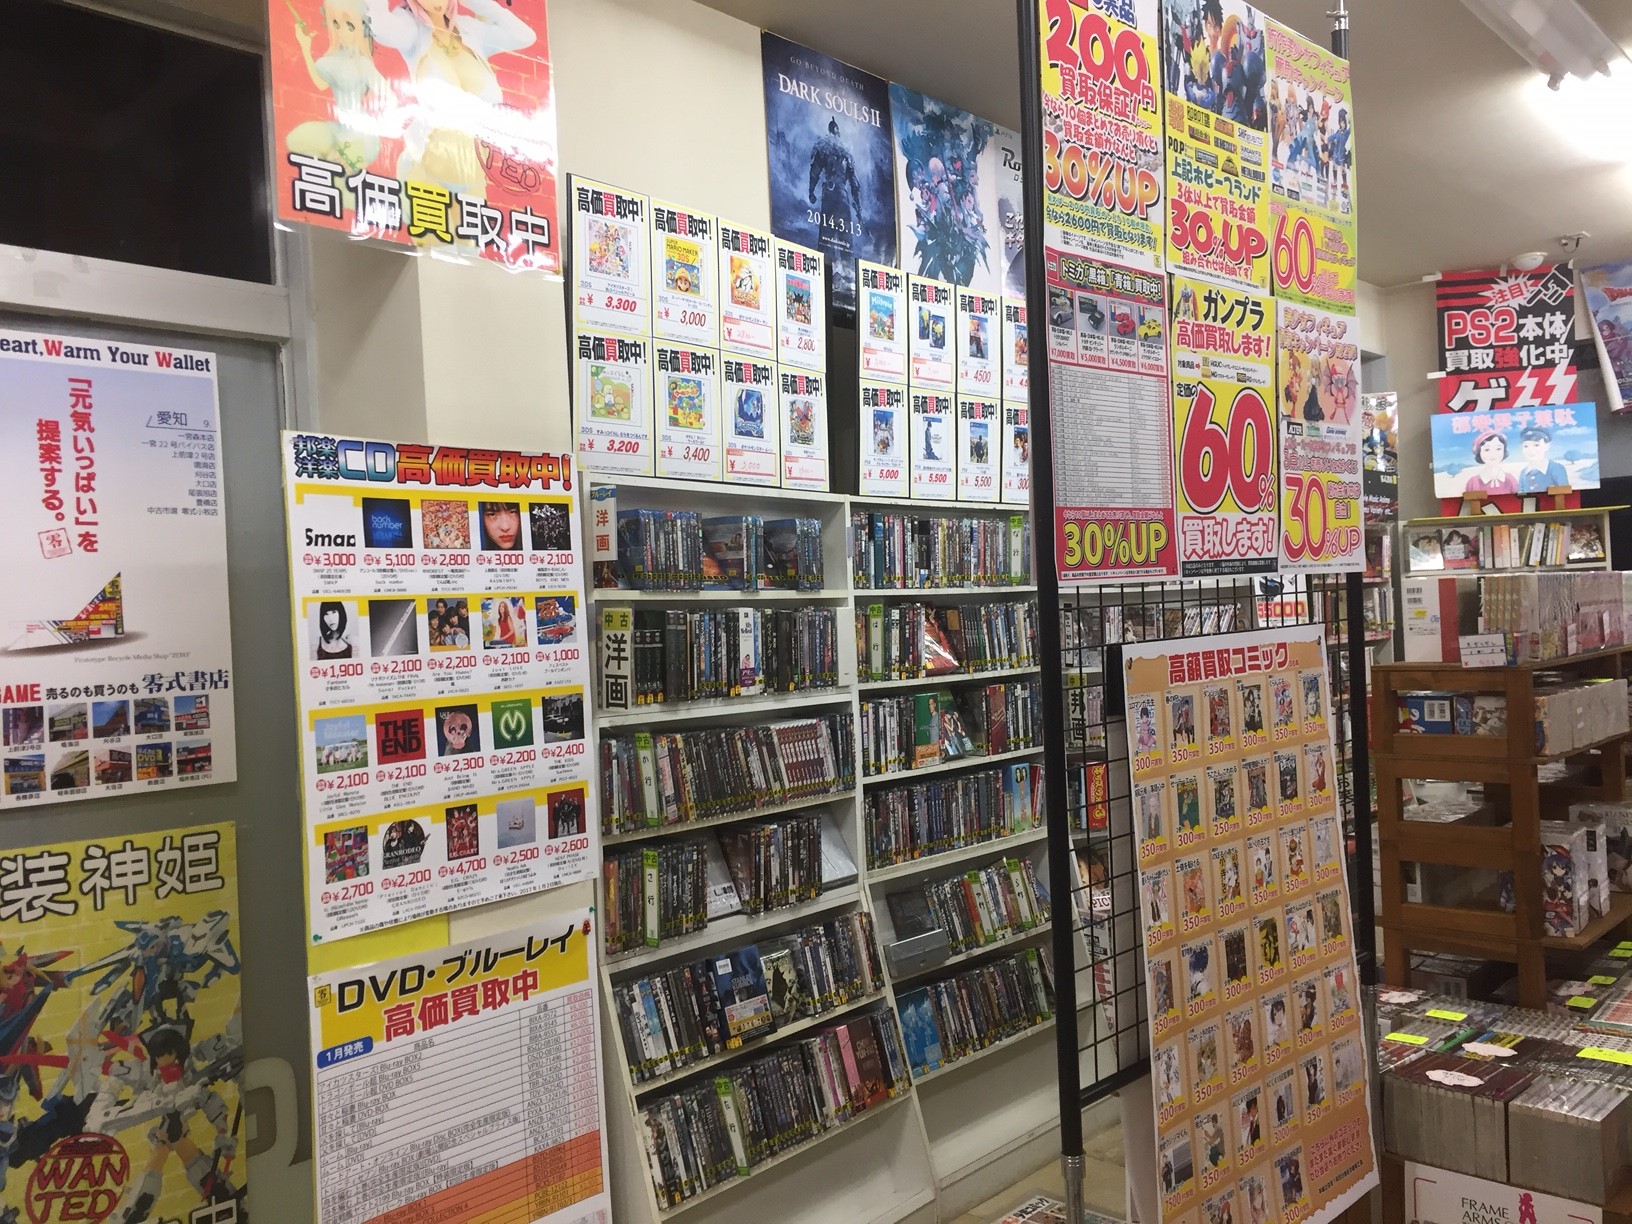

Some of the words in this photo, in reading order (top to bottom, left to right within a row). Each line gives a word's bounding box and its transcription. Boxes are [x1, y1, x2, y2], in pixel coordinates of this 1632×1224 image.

[777, 73, 821, 106] DARK
[825, 91, 870, 124] SOULS
[871, 108, 882, 128] II
[1059, 63, 1140, 123] 買取保証!
[1044, 129, 1159, 219] 30%UP
[287, 151, 550, 257] 高価買取中
[577, 186, 644, 223] 高価買取中!
[1177, 182, 1256, 224] 3体以上で買取金額
[654, 206, 712, 241] 高価買取中!
[806, 209, 863, 238] 2014.3.13
[1170, 198, 1267, 266] 30%UP
[720, 226, 771, 259] 高価買取中!
[777, 247, 821, 277] 高価買取中!
[1182, 250, 1253, 281] 組み合わせは自由です!
[861, 267, 904, 294] 高価買取中!
[1492, 280, 1532, 305] 注目!
[605, 294, 637, 313] 3,300
[911, 283, 951, 306] 高価買取中!
[959, 294, 998, 316] 高価買取中!
[680, 309, 707, 328] 3,000
[1203, 289, 1264, 331] ガンプラ
[577, 335, 648, 365] 高価買取中!
[1176, 320, 1272, 358] 高価買取します!
[107, 345, 149, 366] Your
[155, 350, 211, 373] Wallet
[656, 348, 716, 376] 高価買取中!
[1445, 342, 1569, 373] 買取強化中
[723, 360, 774, 387] 高価買取中!
[780, 373, 823, 398] 高価買取中!
[862, 387, 904, 409] 高価買取中!
[912, 395, 952, 415] 高価買取中!
[156, 410, 188, 427] 愛知
[959, 401, 998, 421] 高価買取中!
[606, 439, 640, 454] 3,200
[683, 446, 710, 462] 3,400
[36, 418, 66, 522] 提案する。
[67, 377, 99, 553] 「元気いっぱい」を
[879, 468, 899, 480] 5,000
[928, 473, 947, 484] 5,500
[974, 476, 992, 488] 5,500
[595, 509, 611, 553] 洋画
[1010, 517, 1023, 526] 中古
[1063, 521, 1168, 567] 30%UP
[1181, 515, 1276, 560] 買取します!
[604, 612, 629, 629] 中古
[604, 632, 629, 710] 洋画
[1168, 641, 1289, 685] 高額買取コミック
[0, 683, 42, 703] AME
[45, 683, 140, 701] 売るのも買うのも
[142, 669, 230, 694] 零式書店
[379, 718, 420, 737] THE
[380, 736, 422, 758] END
[636, 735, 650, 746] 中古
[643, 852, 657, 864] 中古
[337, 924, 575, 1014] DVD・ブルーレイ
[382, 969, 539, 1043] 高価買取中
[325, 1041, 364, 1062] 1月発売
[413, 1039, 435, 1052] 商品名
[402, 1063, 421, 1075] BOX5
[405, 1053, 423, 1065] BOX2
[379, 1081, 394, 1092] DVD
[395, 1075, 414, 1086] BOX5
[382, 1090, 396, 1101] BOX
[1461, 1197, 1510, 1220] FRAME
